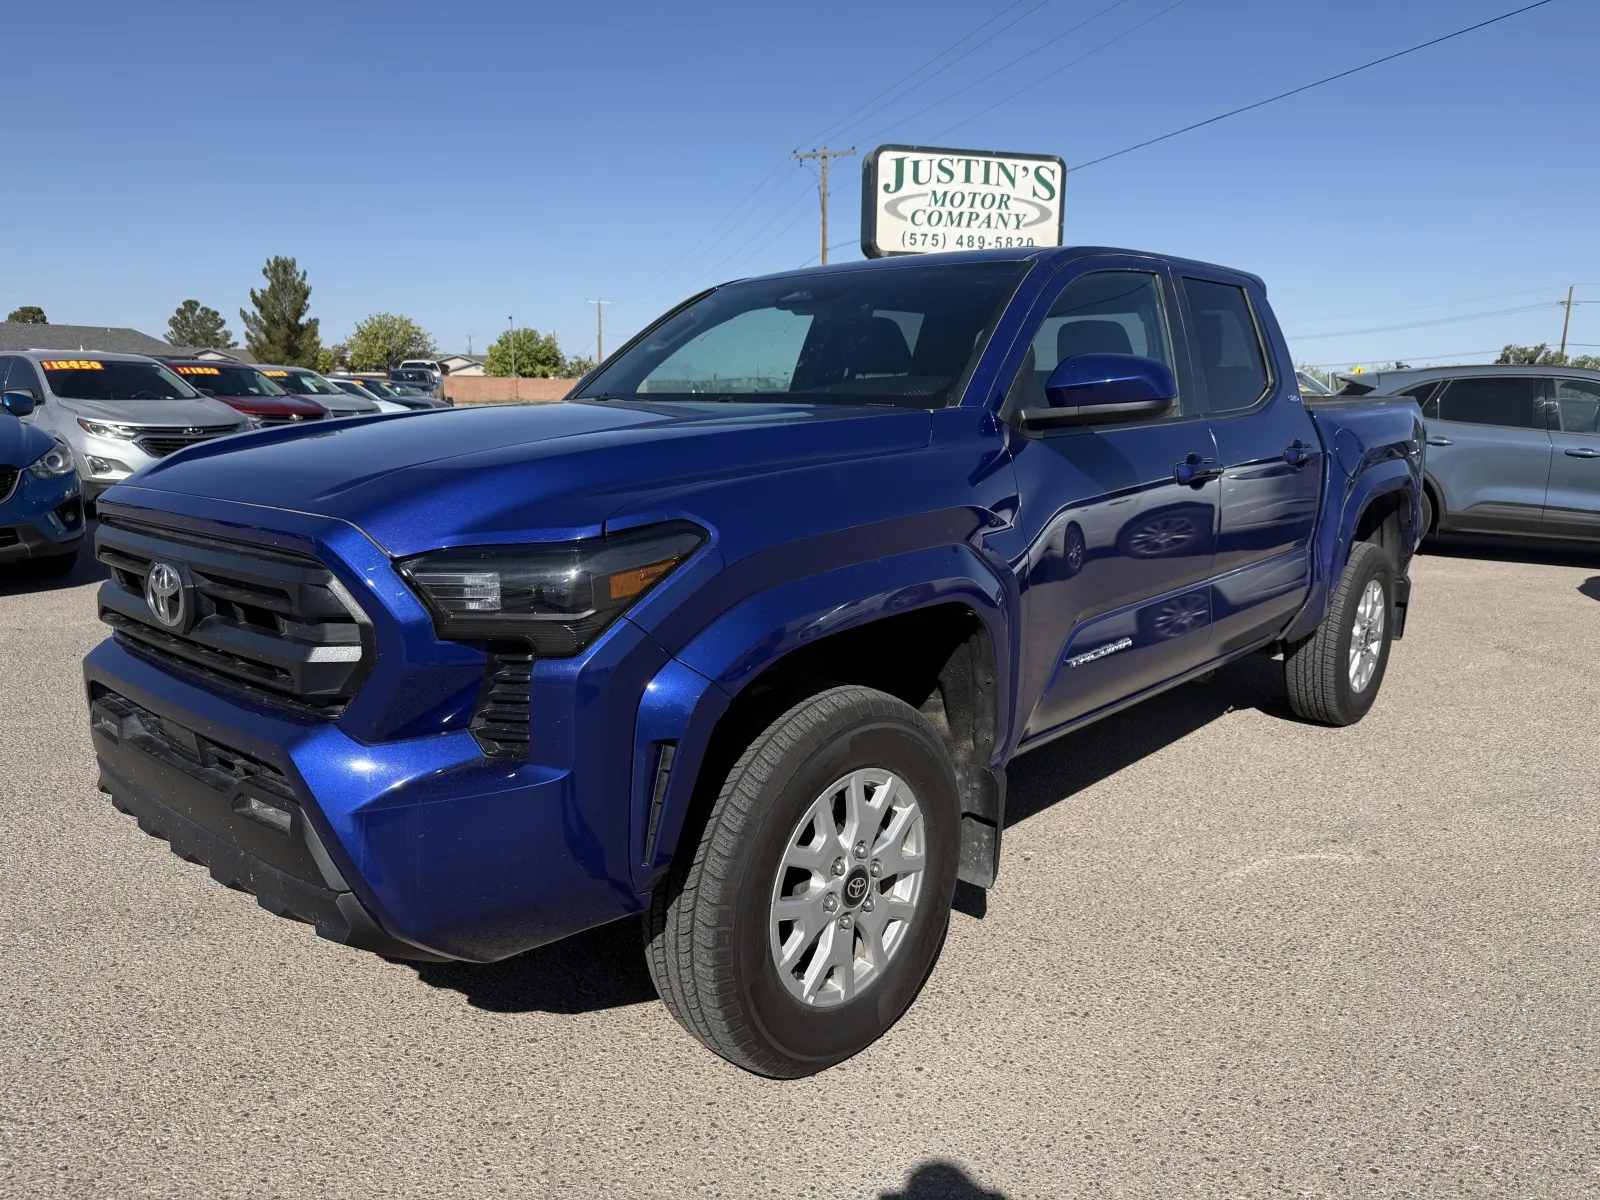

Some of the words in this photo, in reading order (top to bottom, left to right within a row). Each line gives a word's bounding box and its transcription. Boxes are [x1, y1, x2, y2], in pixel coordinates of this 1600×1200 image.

[883, 156, 1056, 201] JUSTIN'S
[928, 190, 1011, 210] MOTOR
[910, 209, 1028, 230] COMPANY
[901, 231, 947, 249] (575)
[956, 234, 1034, 249] 489-5820
